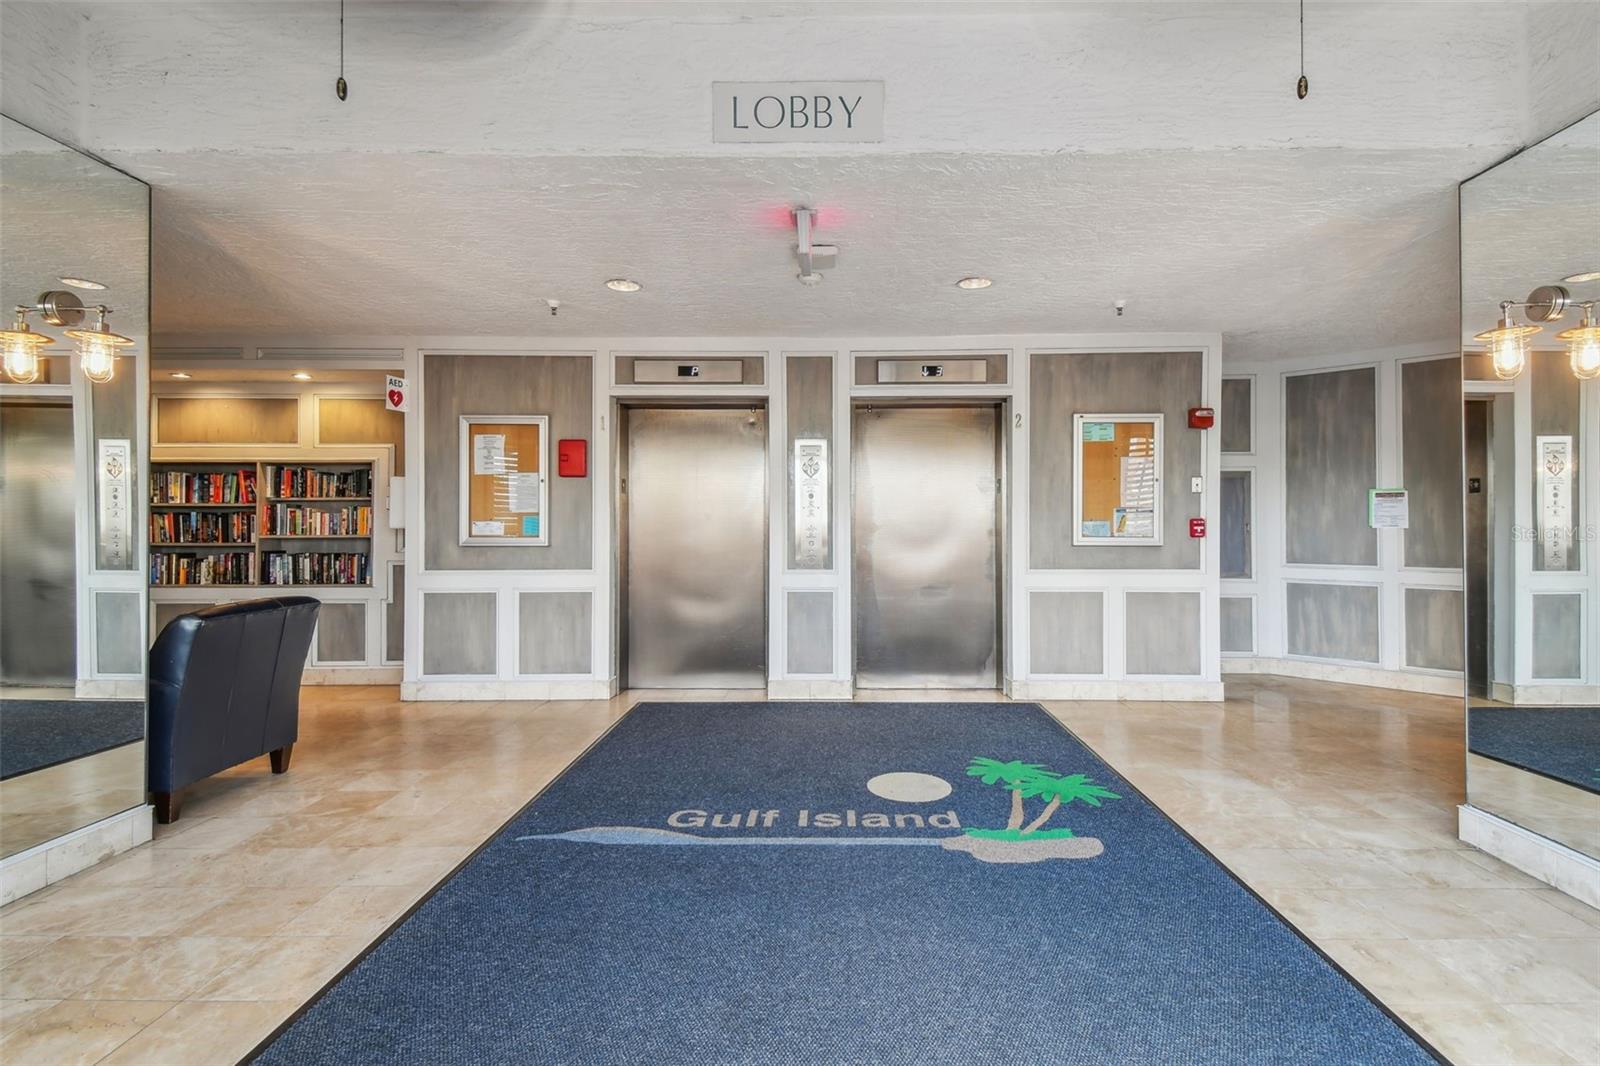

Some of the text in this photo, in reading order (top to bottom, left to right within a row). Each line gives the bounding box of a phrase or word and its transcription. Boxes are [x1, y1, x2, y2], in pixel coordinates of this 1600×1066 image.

[732, 95, 862, 129] LOBBY
[388, 378, 404, 388] AED
[1014, 412, 1022, 429] 2
[666, 809, 961, 828] Gulf Island
